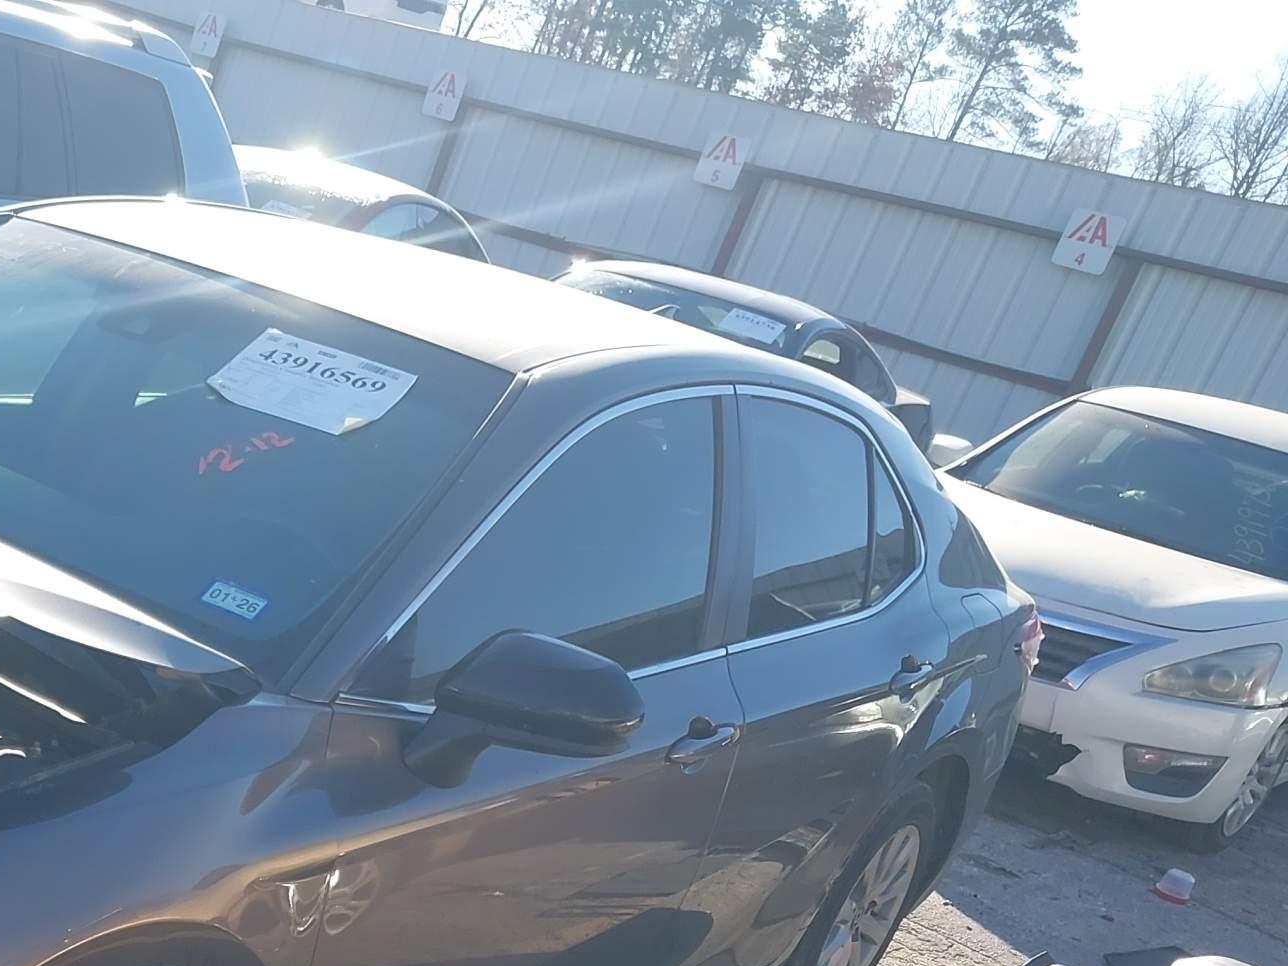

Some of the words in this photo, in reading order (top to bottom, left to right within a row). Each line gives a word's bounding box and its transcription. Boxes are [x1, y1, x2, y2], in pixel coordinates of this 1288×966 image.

[710, 169, 721, 183] 5
[1073, 252, 1086, 266] 4
[258, 349, 387, 393] 43916569
